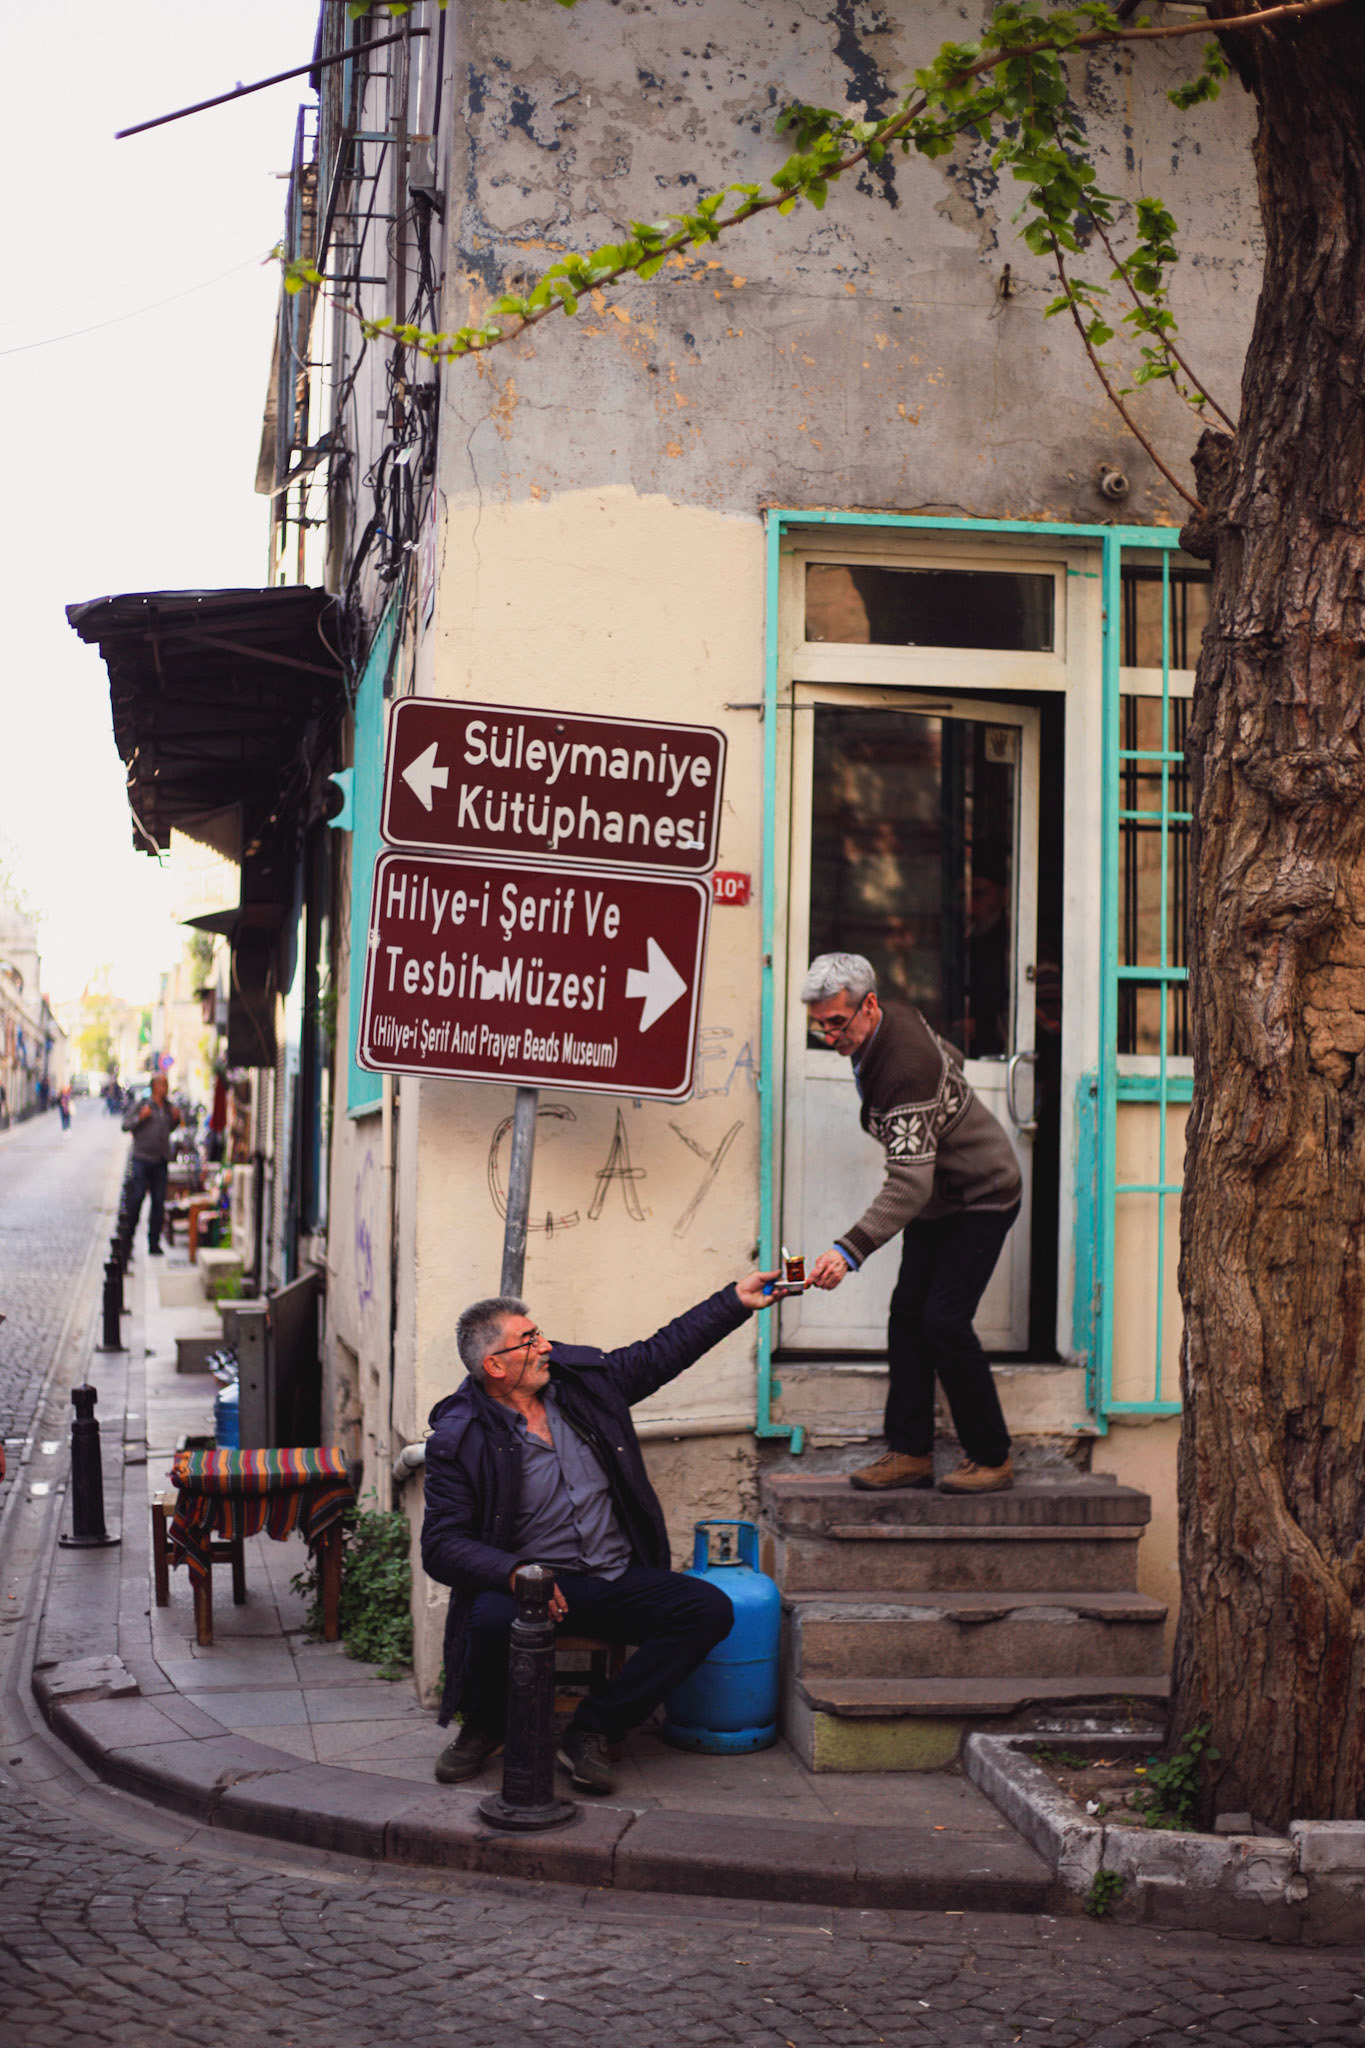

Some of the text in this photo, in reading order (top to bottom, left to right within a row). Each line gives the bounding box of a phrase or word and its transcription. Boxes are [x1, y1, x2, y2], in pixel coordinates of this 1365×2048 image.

[463, 720, 712, 797] Süleymaniye
[457, 784, 707, 850] Kütüphanesi
[386, 872, 621, 942] Hilye-i Şerif Ve
[714, 877, 745, 898] 10A
[386, 945, 607, 1011] Tesbih Müzesi
[373, 1014, 618, 1068] (Hilye-i Şerif And Prayer Beads Museum)
